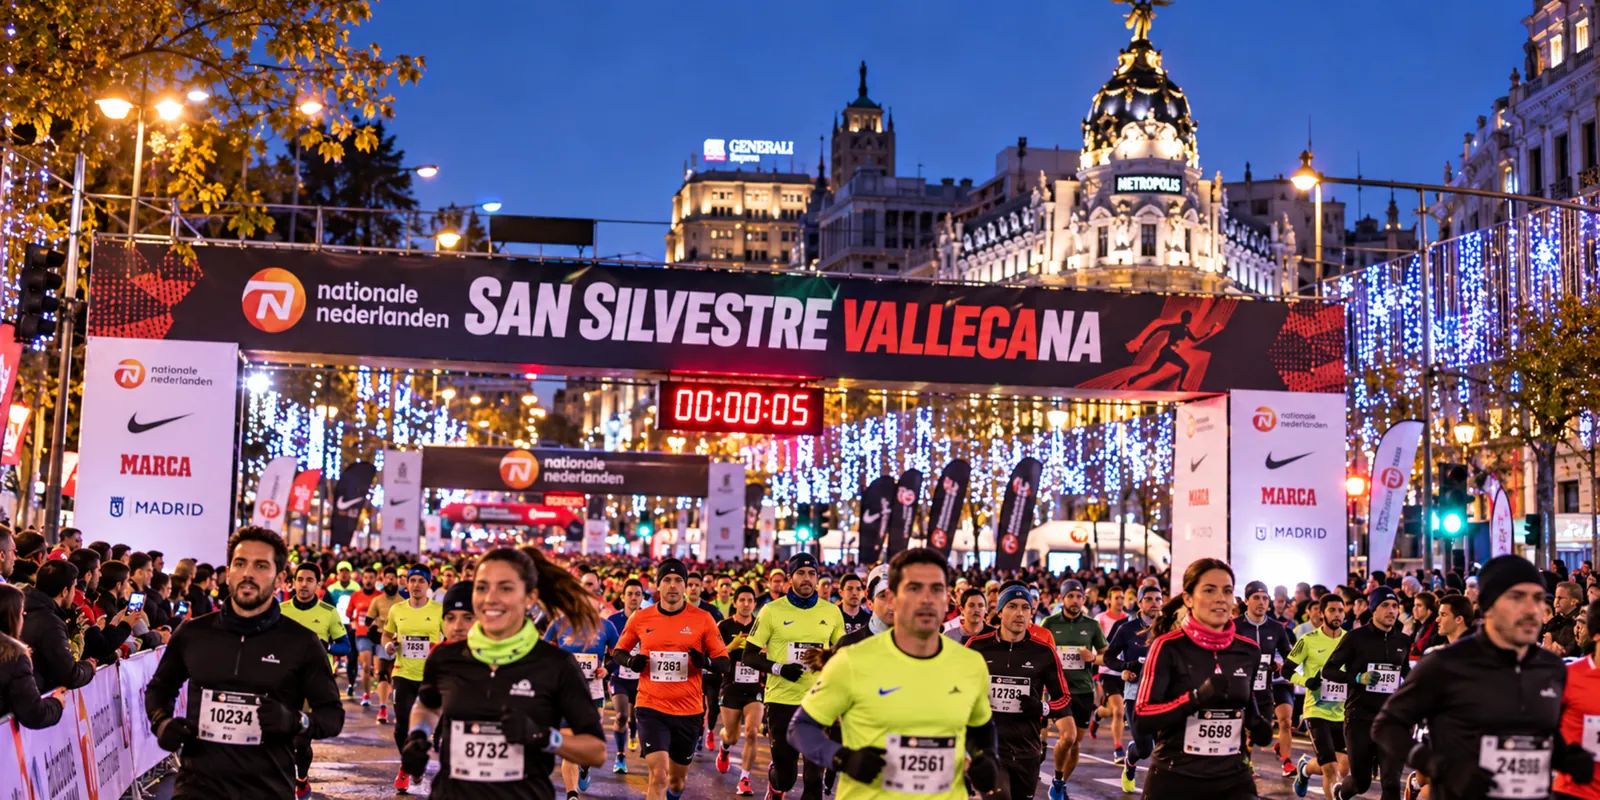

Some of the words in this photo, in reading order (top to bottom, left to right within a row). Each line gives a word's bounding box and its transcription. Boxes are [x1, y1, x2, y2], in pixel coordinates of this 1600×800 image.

[729, 139, 793, 155] GENERALI
[1117, 176, 1181, 192] METROPOLIS
[317, 282, 418, 304] nationale
[316, 304, 450, 329] nederlanden
[464, 276, 572, 337] SAN
[579, 282, 832, 350] SILVESTRE
[844, 299, 1101, 363] VALLECANA
[151, 365, 198, 375] nationale
[150, 375, 213, 386] nederlanden
[674, 389, 809, 426] 00:00:05
[1280, 412, 1316, 420] nationale
[1280, 420, 1328, 429] nederlanden
[120, 454, 192, 477] MARCA
[544, 457, 605, 471] nationale
[544, 470, 624, 485] nederlanden
[1261, 487, 1317, 506] MARCA
[135, 501, 204, 516] MADRID
[1274, 527, 1327, 539] MADRID
[210, 708, 253, 726] 10234
[1198, 725, 1232, 738] 5698
[465, 742, 509, 759] 8732
[899, 755, 945, 772] 12561
